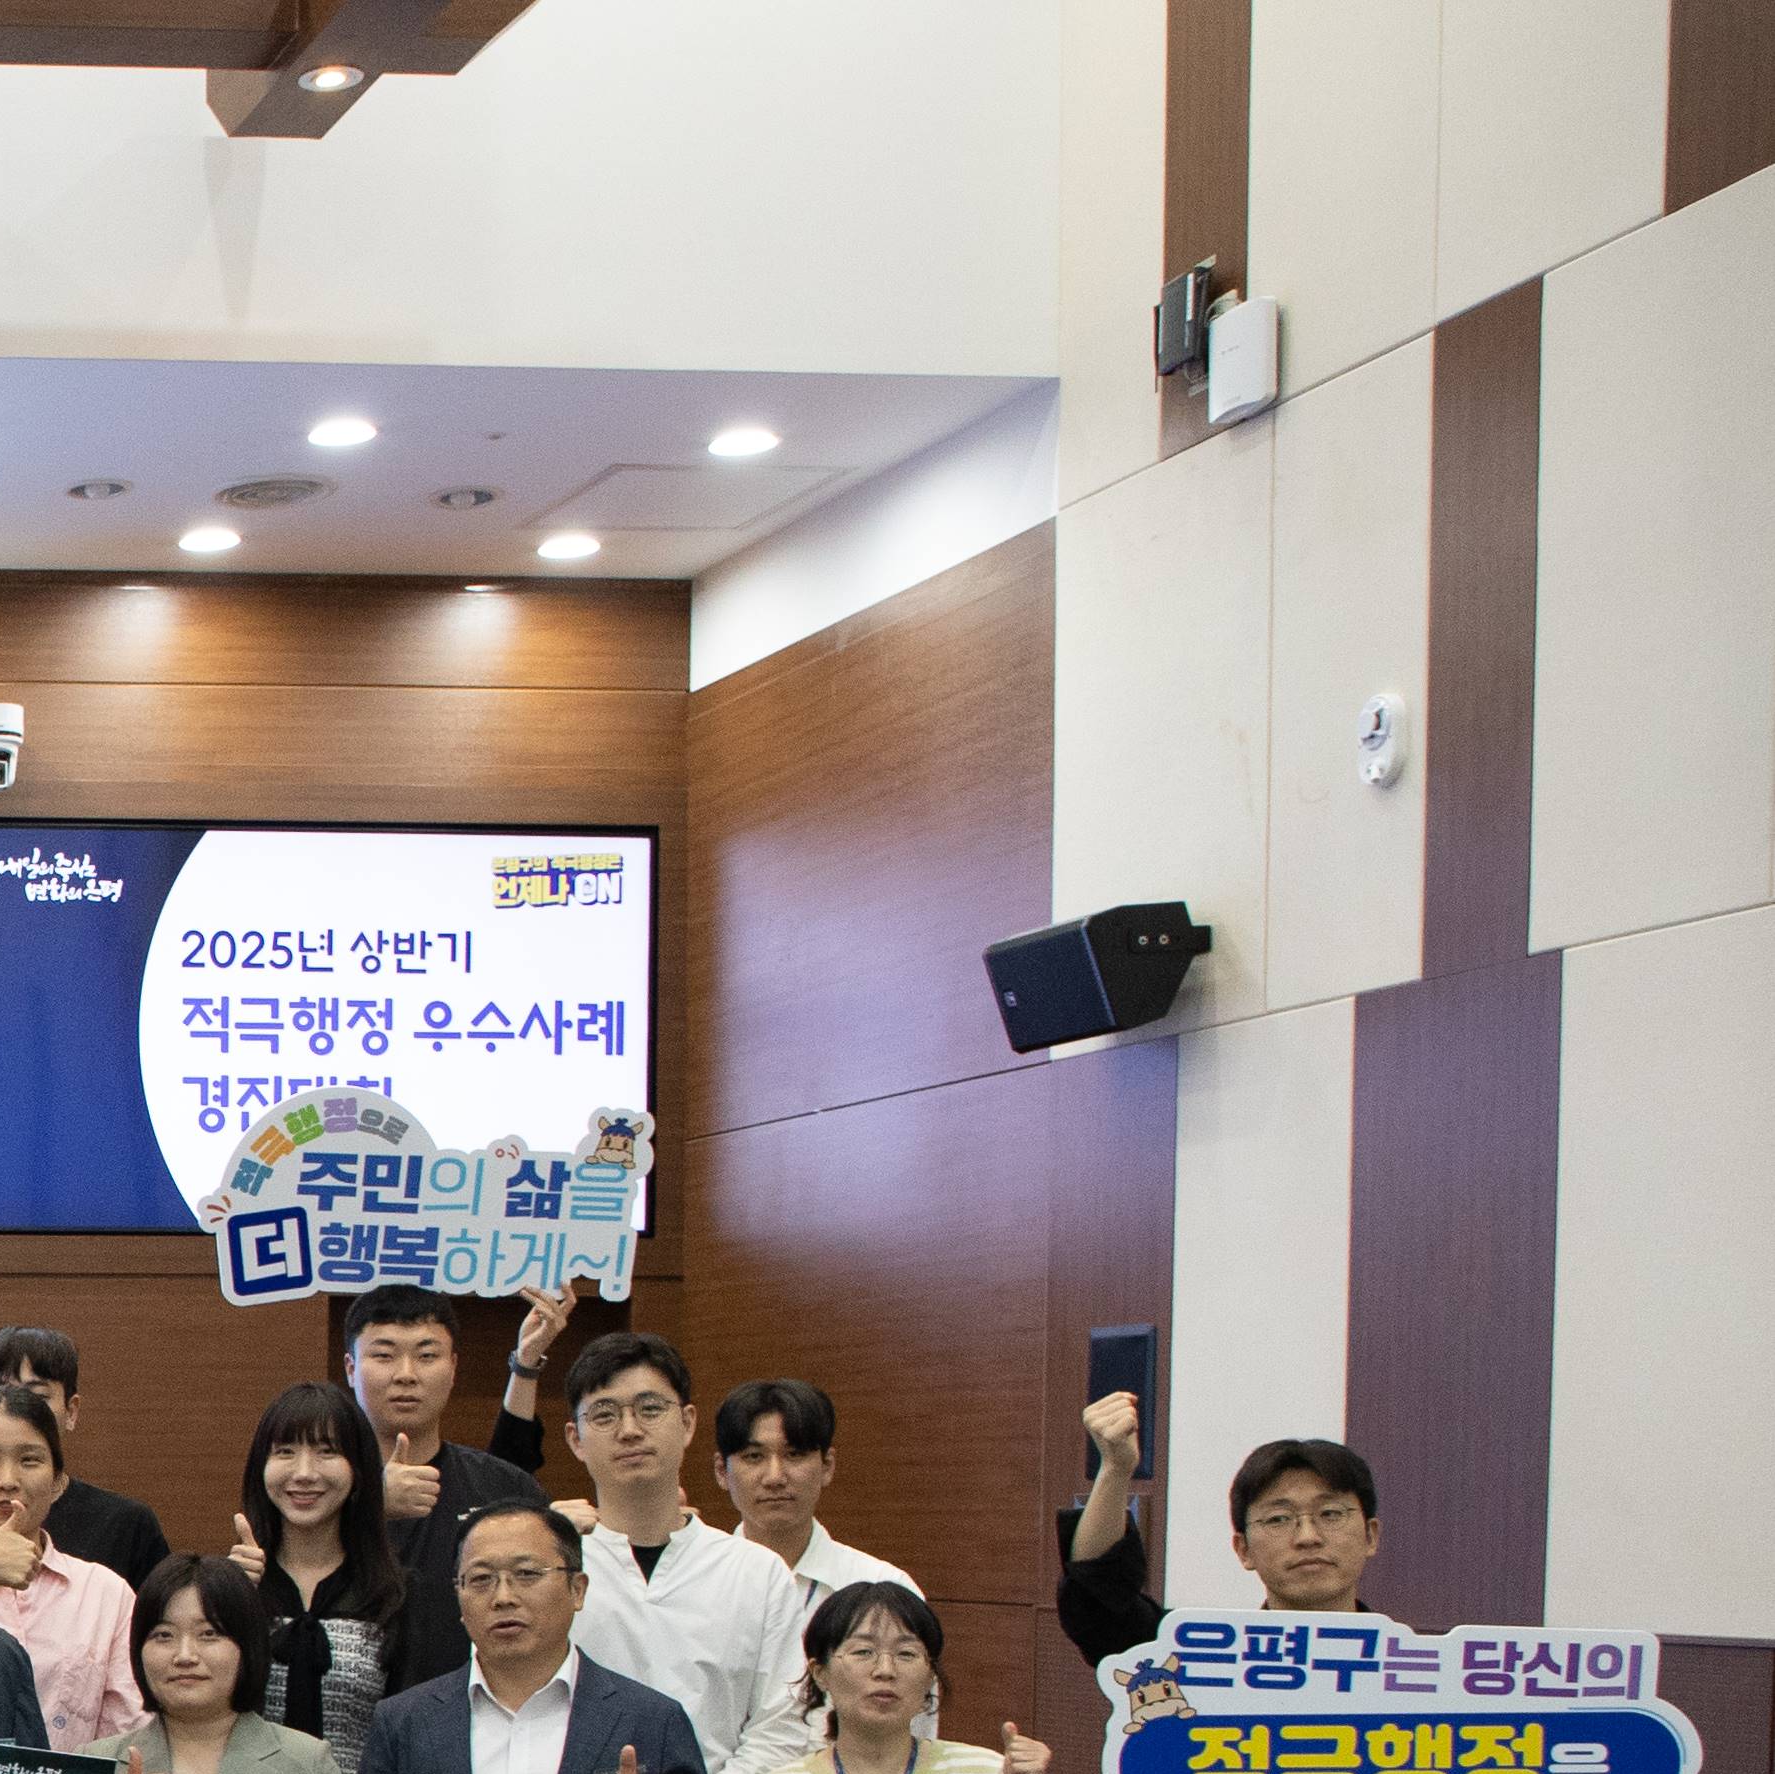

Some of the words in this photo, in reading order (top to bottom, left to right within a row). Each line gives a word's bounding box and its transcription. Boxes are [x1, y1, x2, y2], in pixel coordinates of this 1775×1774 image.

[492, 873, 570, 908] 언제나
[574, 872, 622, 905] ON
[180, 930, 335, 973] 2025년
[350, 928, 473, 974] 상반기
[181, 997, 394, 1058] 적극행정
[412, 1000, 627, 1057] 우수사례
[182, 1074, 392, 1134] 경진
[297, 1150, 485, 1217] 주민의
[505, 1157, 631, 1222] 삶을
[237, 1215, 304, 1284] 더
[1172, 1620, 1442, 1696] 은평구는
[1461, 1639, 1644, 1700] 당신의
